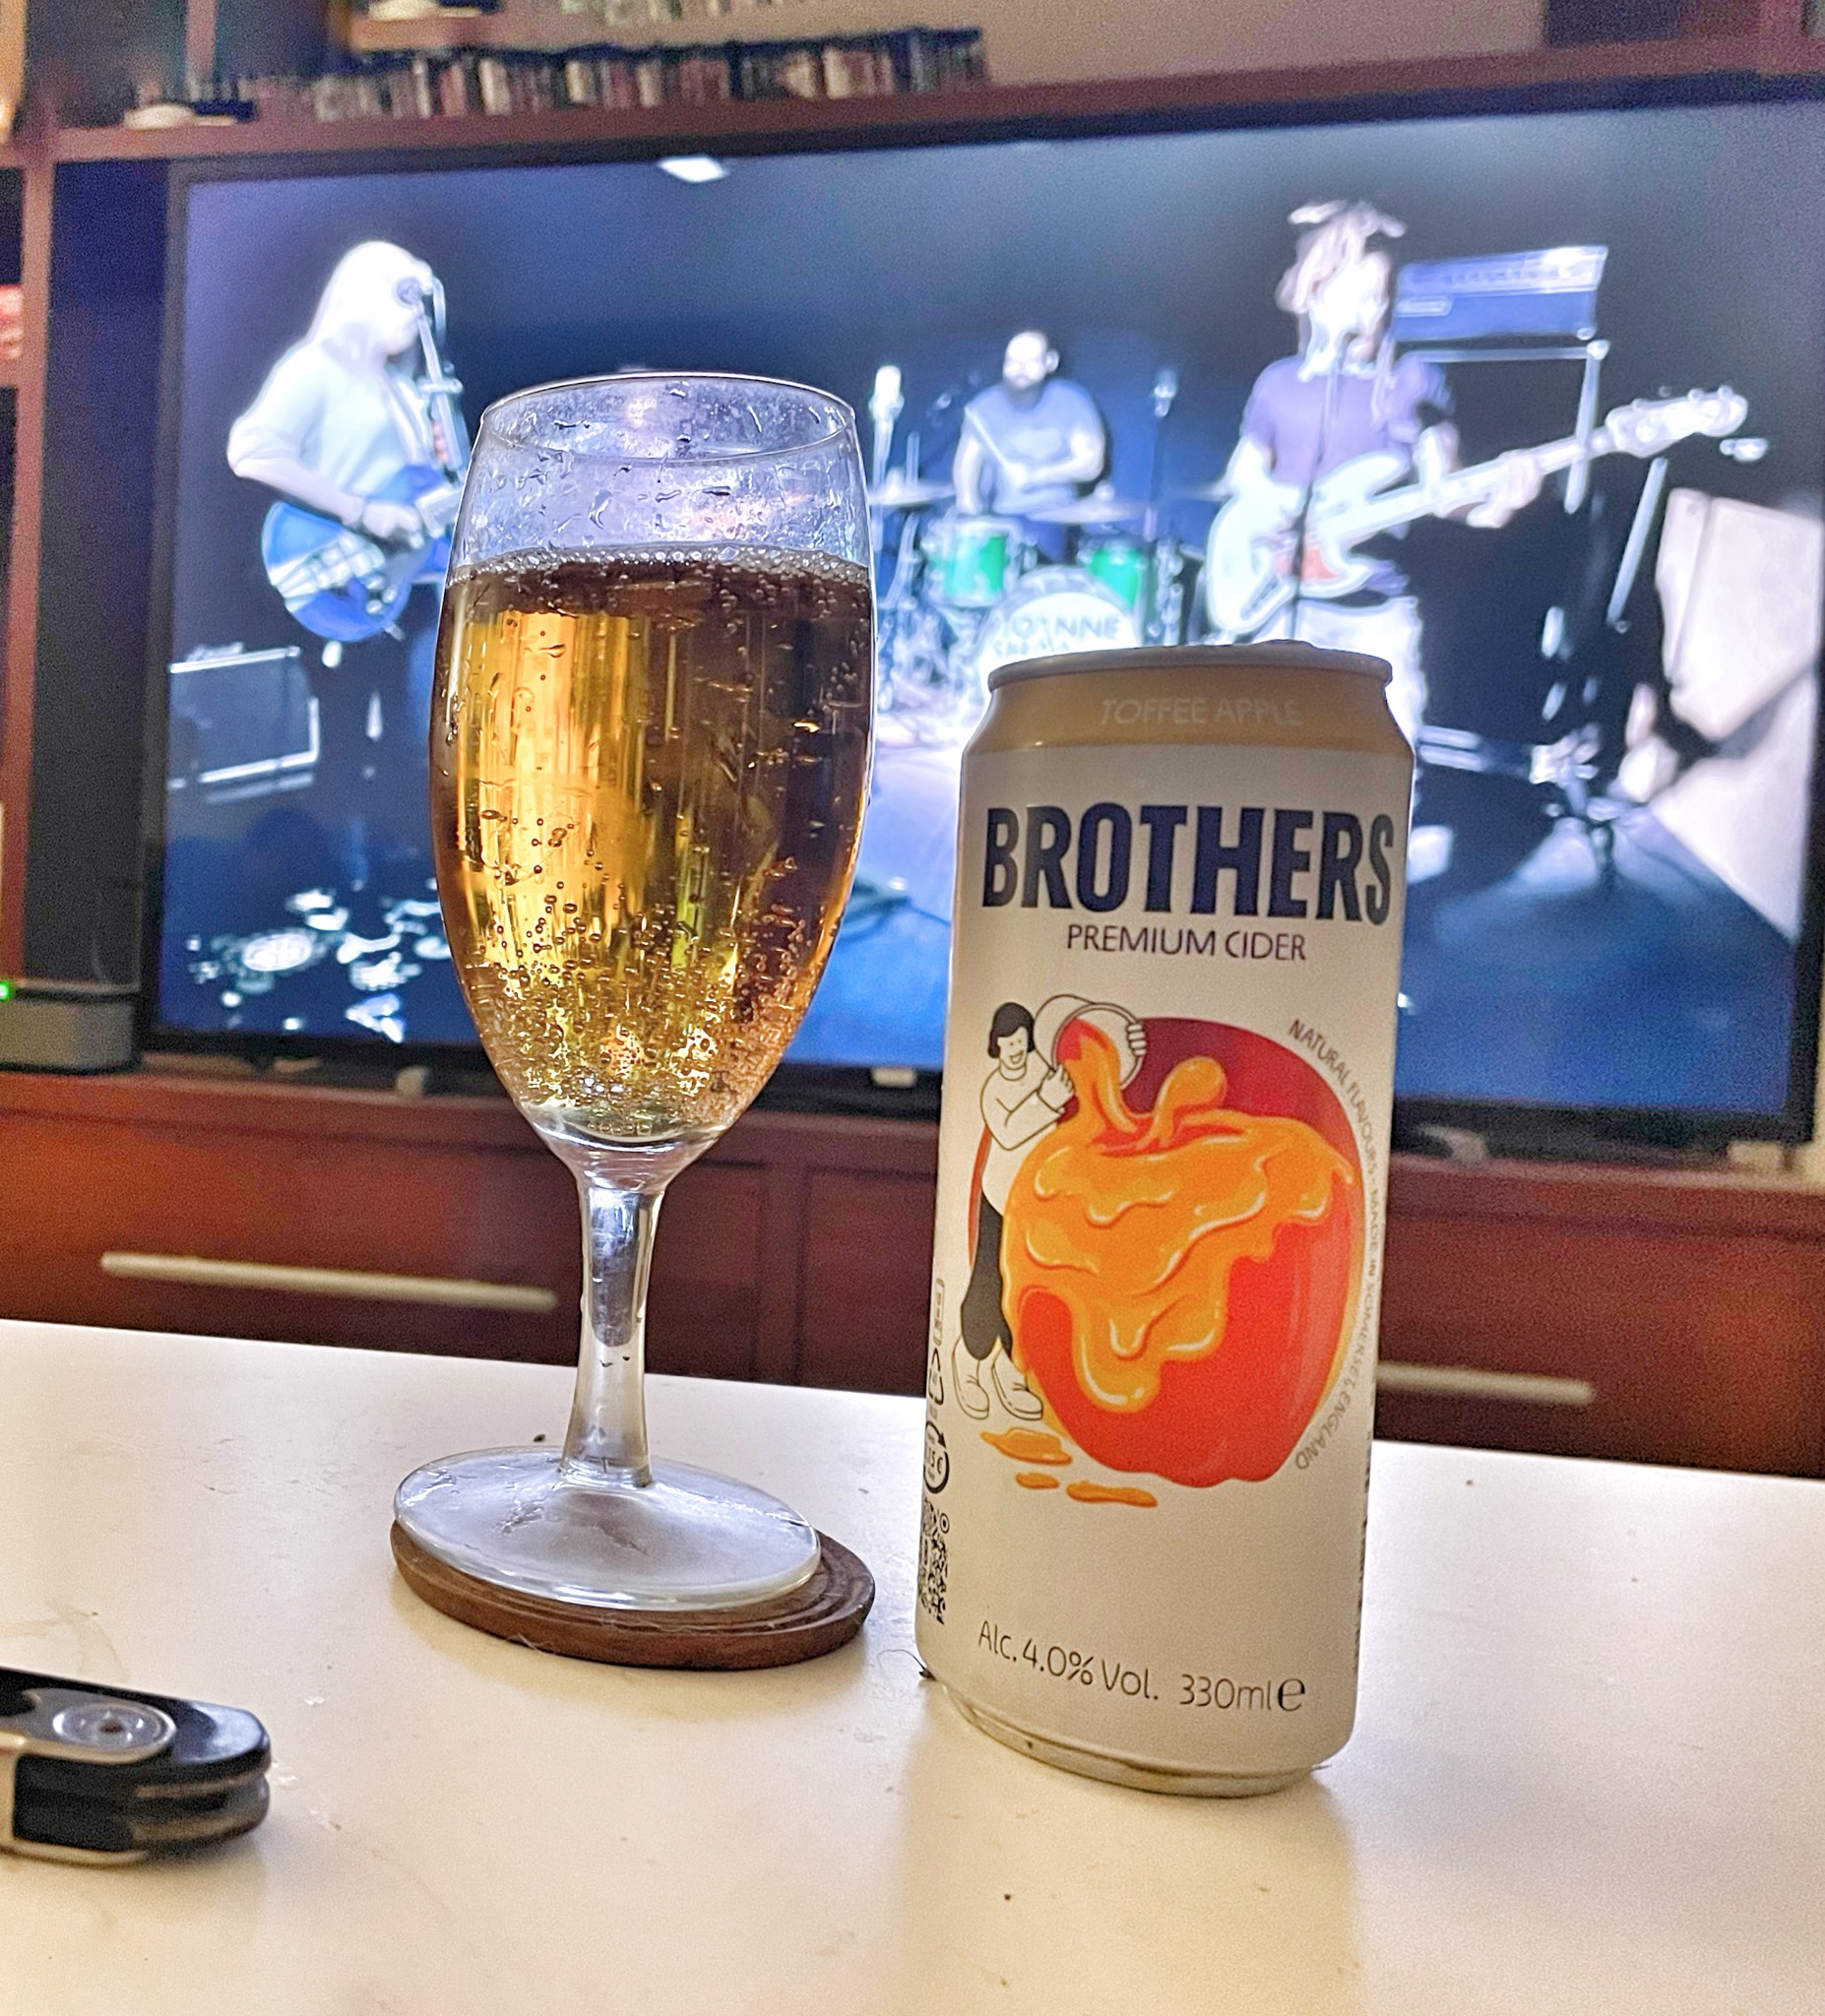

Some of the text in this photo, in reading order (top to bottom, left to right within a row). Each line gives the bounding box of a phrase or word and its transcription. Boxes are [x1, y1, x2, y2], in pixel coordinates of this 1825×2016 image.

[1101, 697, 1304, 727] TOFFEE APPLE
[982, 801, 1395, 926] BROTHERS
[1067, 923, 1306, 962] PREMIUM CIDER
[1289, 1018, 1352, 1086] NATURAL
[1293, 1389, 1353, 1471] ENGLAND
[977, 1619, 1018, 1663] Alc.
[1022, 1637, 1096, 1686] 4.0%
[1101, 1658, 1160, 1702] Vol.
